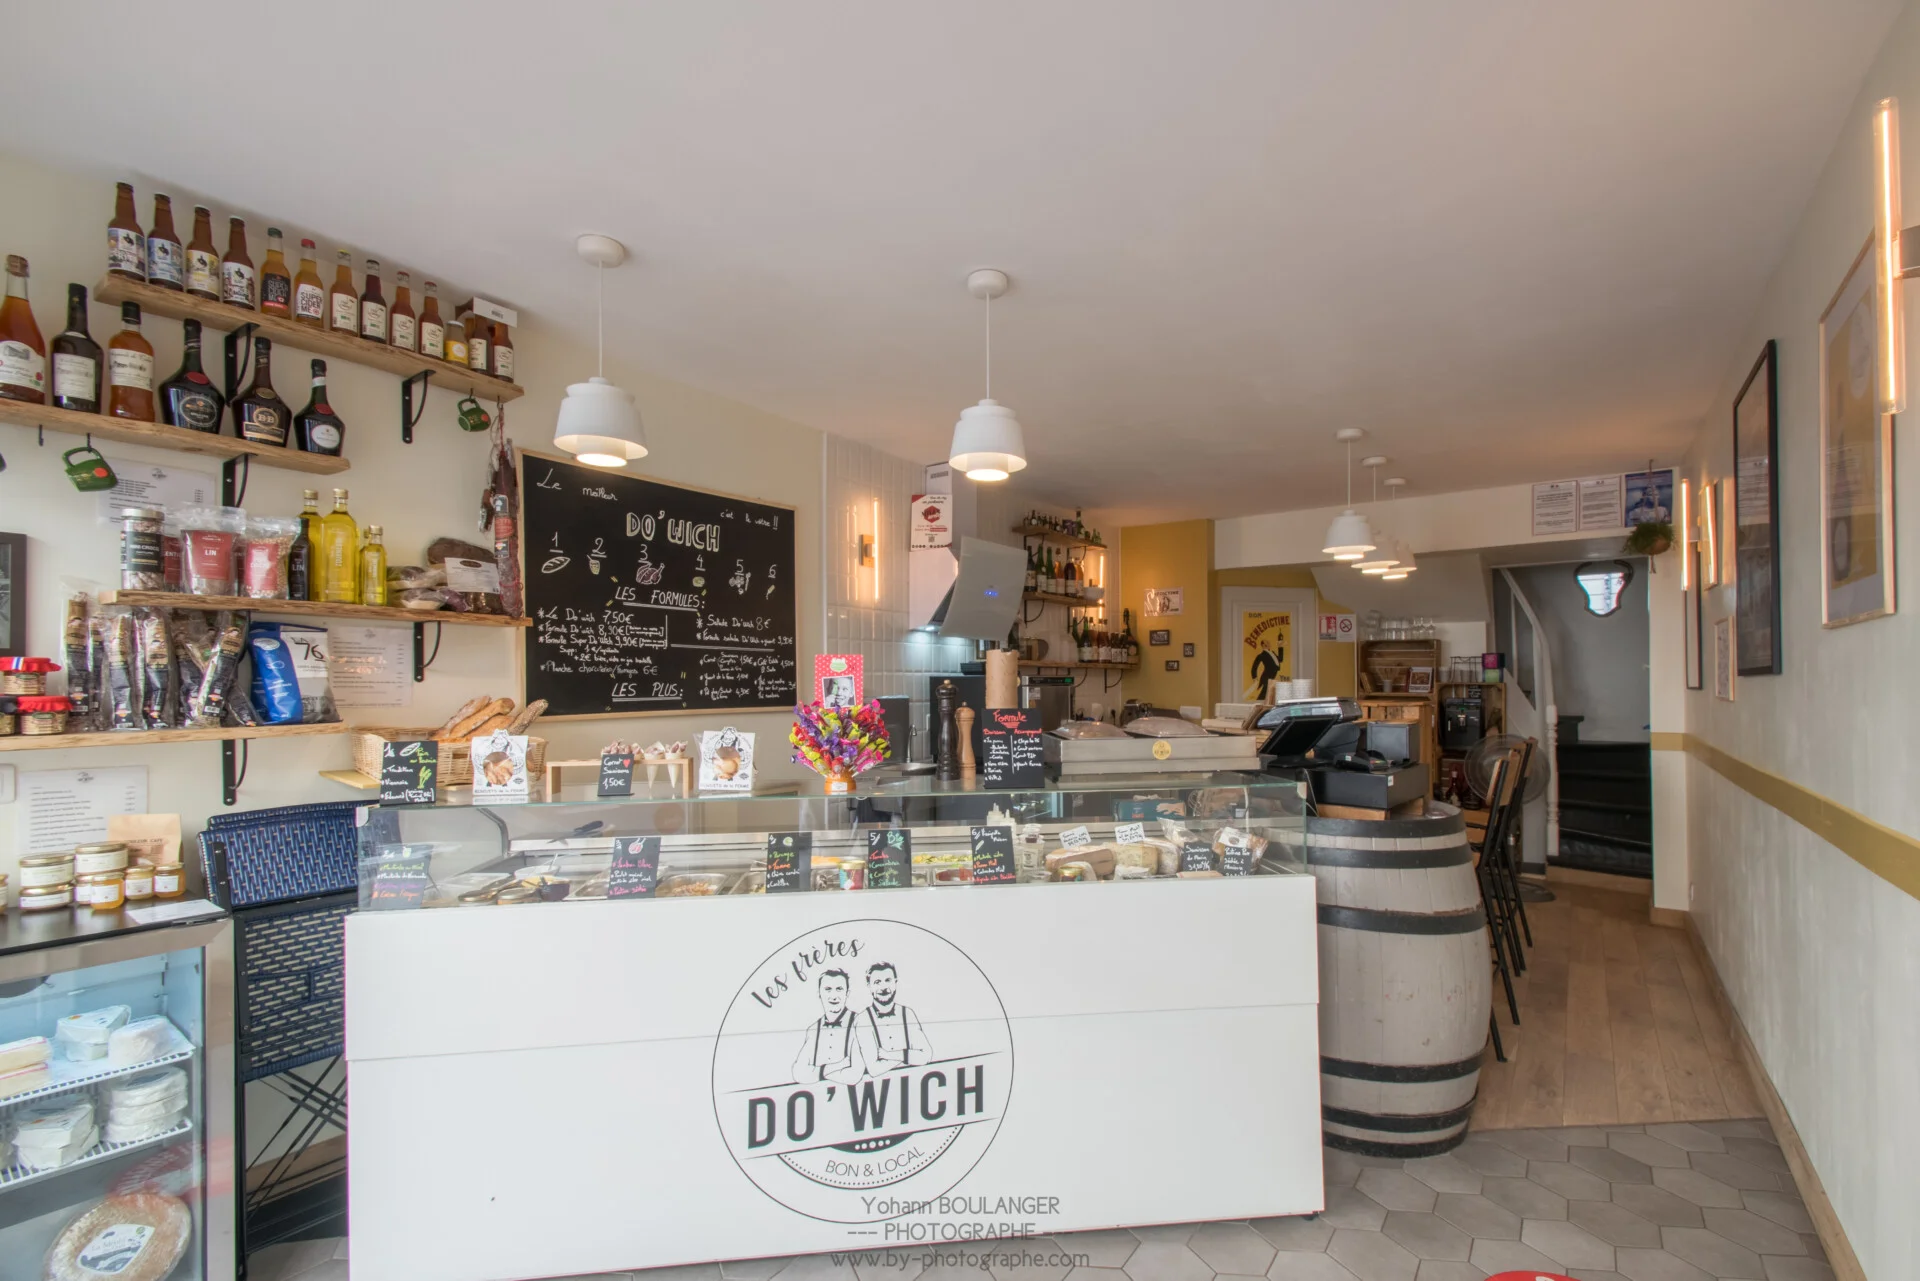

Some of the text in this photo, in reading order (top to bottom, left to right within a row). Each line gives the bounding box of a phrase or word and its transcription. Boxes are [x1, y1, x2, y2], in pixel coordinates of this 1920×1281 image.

[301, 292, 323, 304] SUPER
[301, 299, 321, 309] CIDER
[536, 468, 562, 490] Le
[626, 510, 720, 552] DO'WICH
[552, 532, 558, 547] 1
[592, 538, 606, 555] 2
[640, 544, 649, 561] 3
[696, 554, 704, 568] 4
[736, 560, 744, 573] 5
[769, 564, 777, 576] 6
[615, 587, 636, 601] LES
[603, 610, 634, 625] 7,50€
[1244, 616, 1291, 650] BENEDICTINE
[611, 682, 638, 697] LES
[993, 709, 1028, 722] Formule
[602, 778, 626, 790] 1,50€
[792, 939, 865, 982] frères
[747, 1064, 984, 1149] DO'WICH
[825, 1145, 925, 1178] BON & LOCAL
